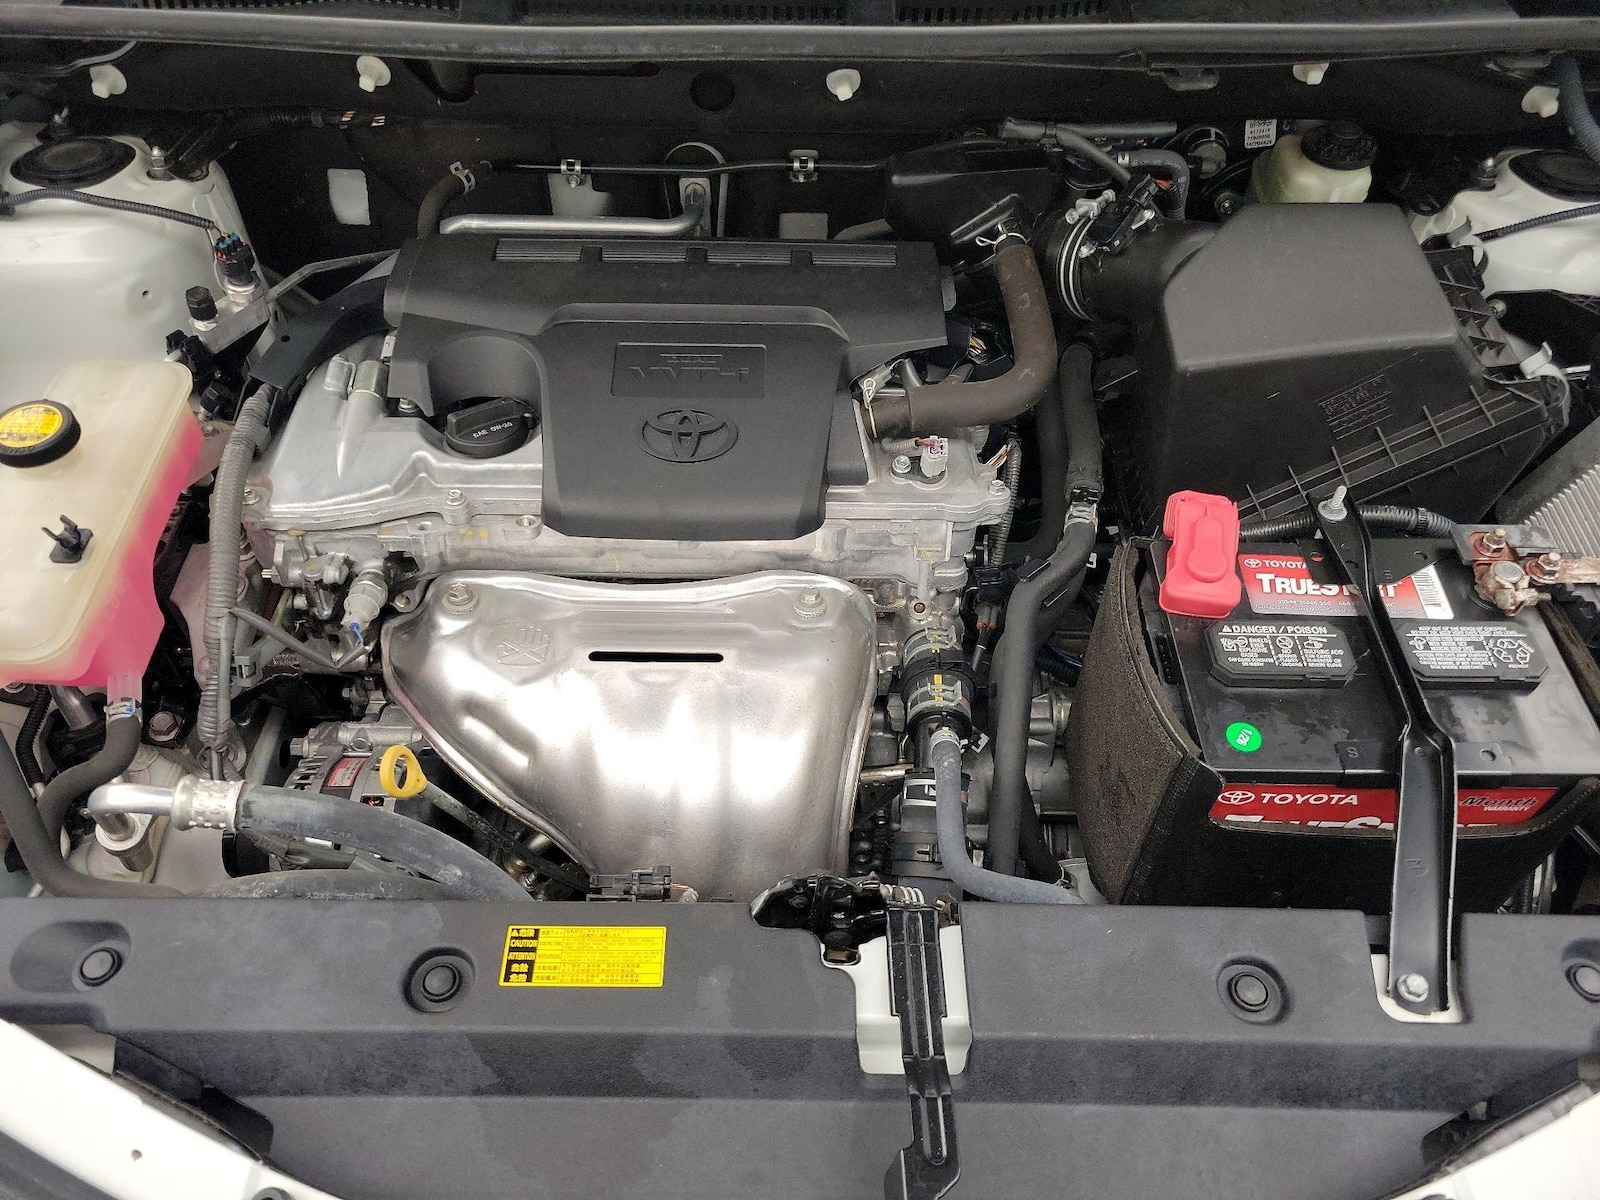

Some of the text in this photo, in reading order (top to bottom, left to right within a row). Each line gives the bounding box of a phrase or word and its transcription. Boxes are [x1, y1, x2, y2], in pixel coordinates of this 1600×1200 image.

[472, 421, 513, 439] SAE 0W-20
[1232, 625, 1277, 634] DANGER
[1287, 626, 1327, 634] POISON
[1260, 793, 1358, 805] TOYOTA
[1461, 796, 1537, 806] Month
[510, 940, 538, 948] CAUTION
[508, 952, 537, 961] ATTENTION
